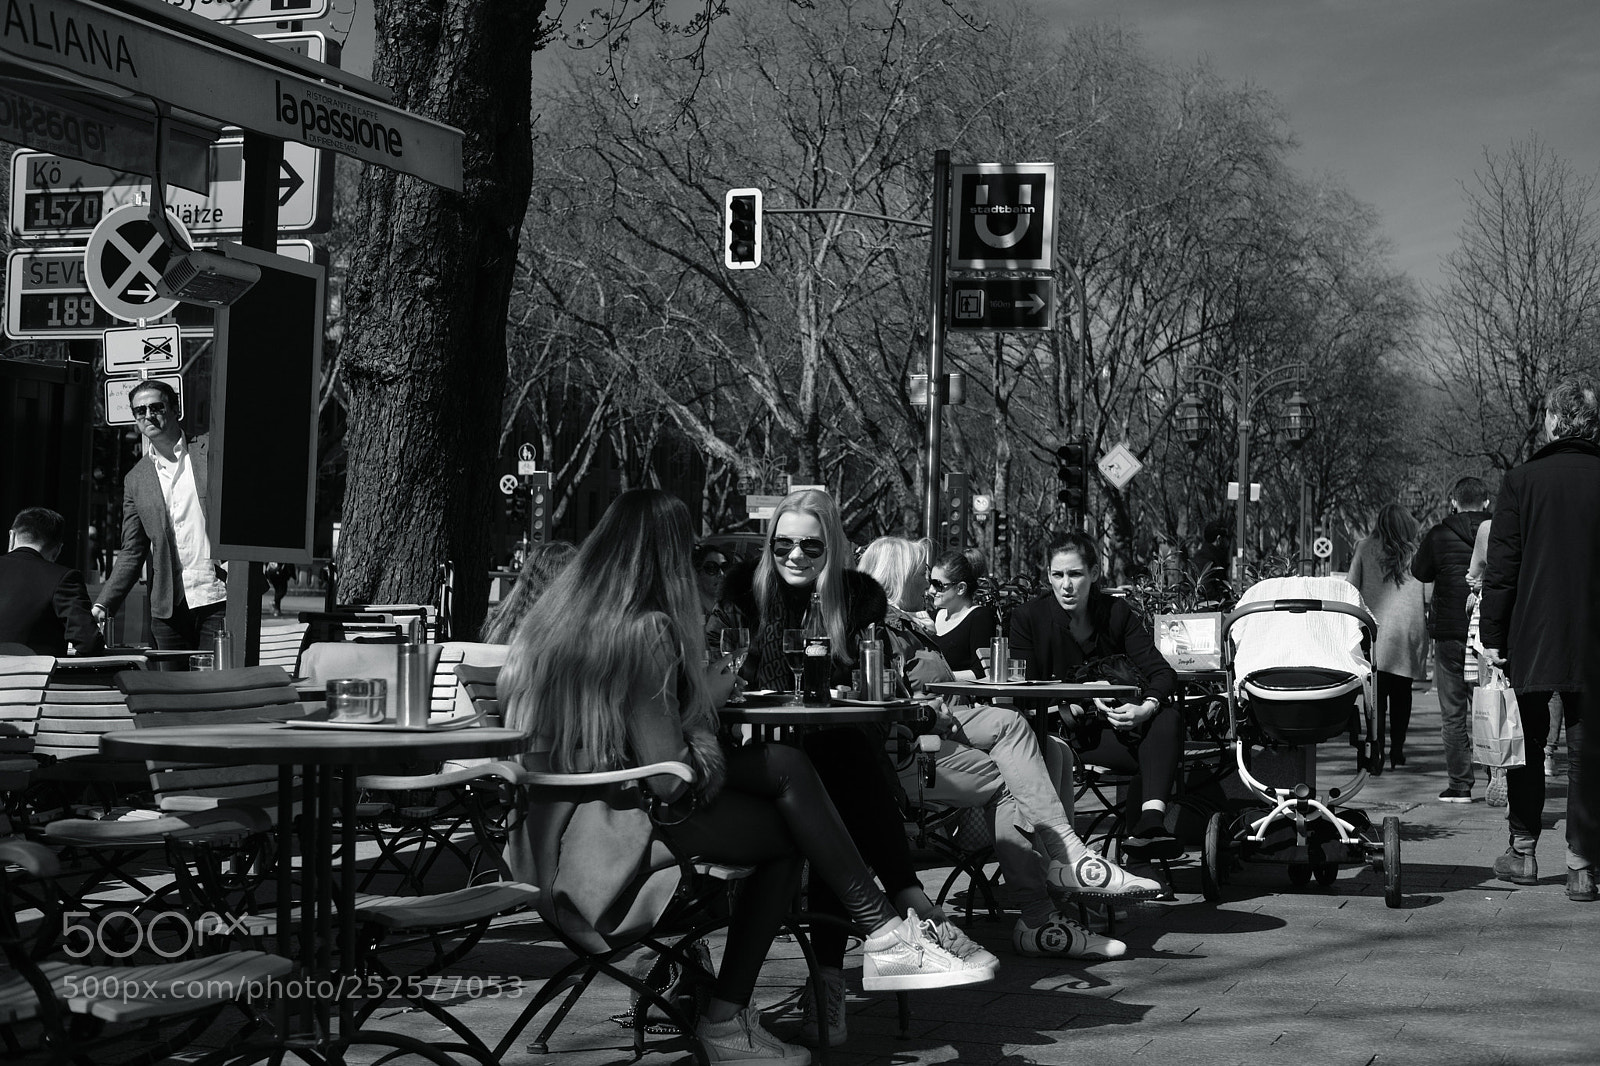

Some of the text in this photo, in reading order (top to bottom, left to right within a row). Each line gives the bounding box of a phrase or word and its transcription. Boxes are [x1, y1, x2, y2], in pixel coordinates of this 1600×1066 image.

[4, 0, 138, 78] ALIANA
[306, 90, 352, 112] RISTORANTE
[33, 161, 62, 184] Kö
[33, 195, 99, 227] 1570
[969, 204, 1036, 214] stadtbahn
[47, 295, 95, 327] 189
